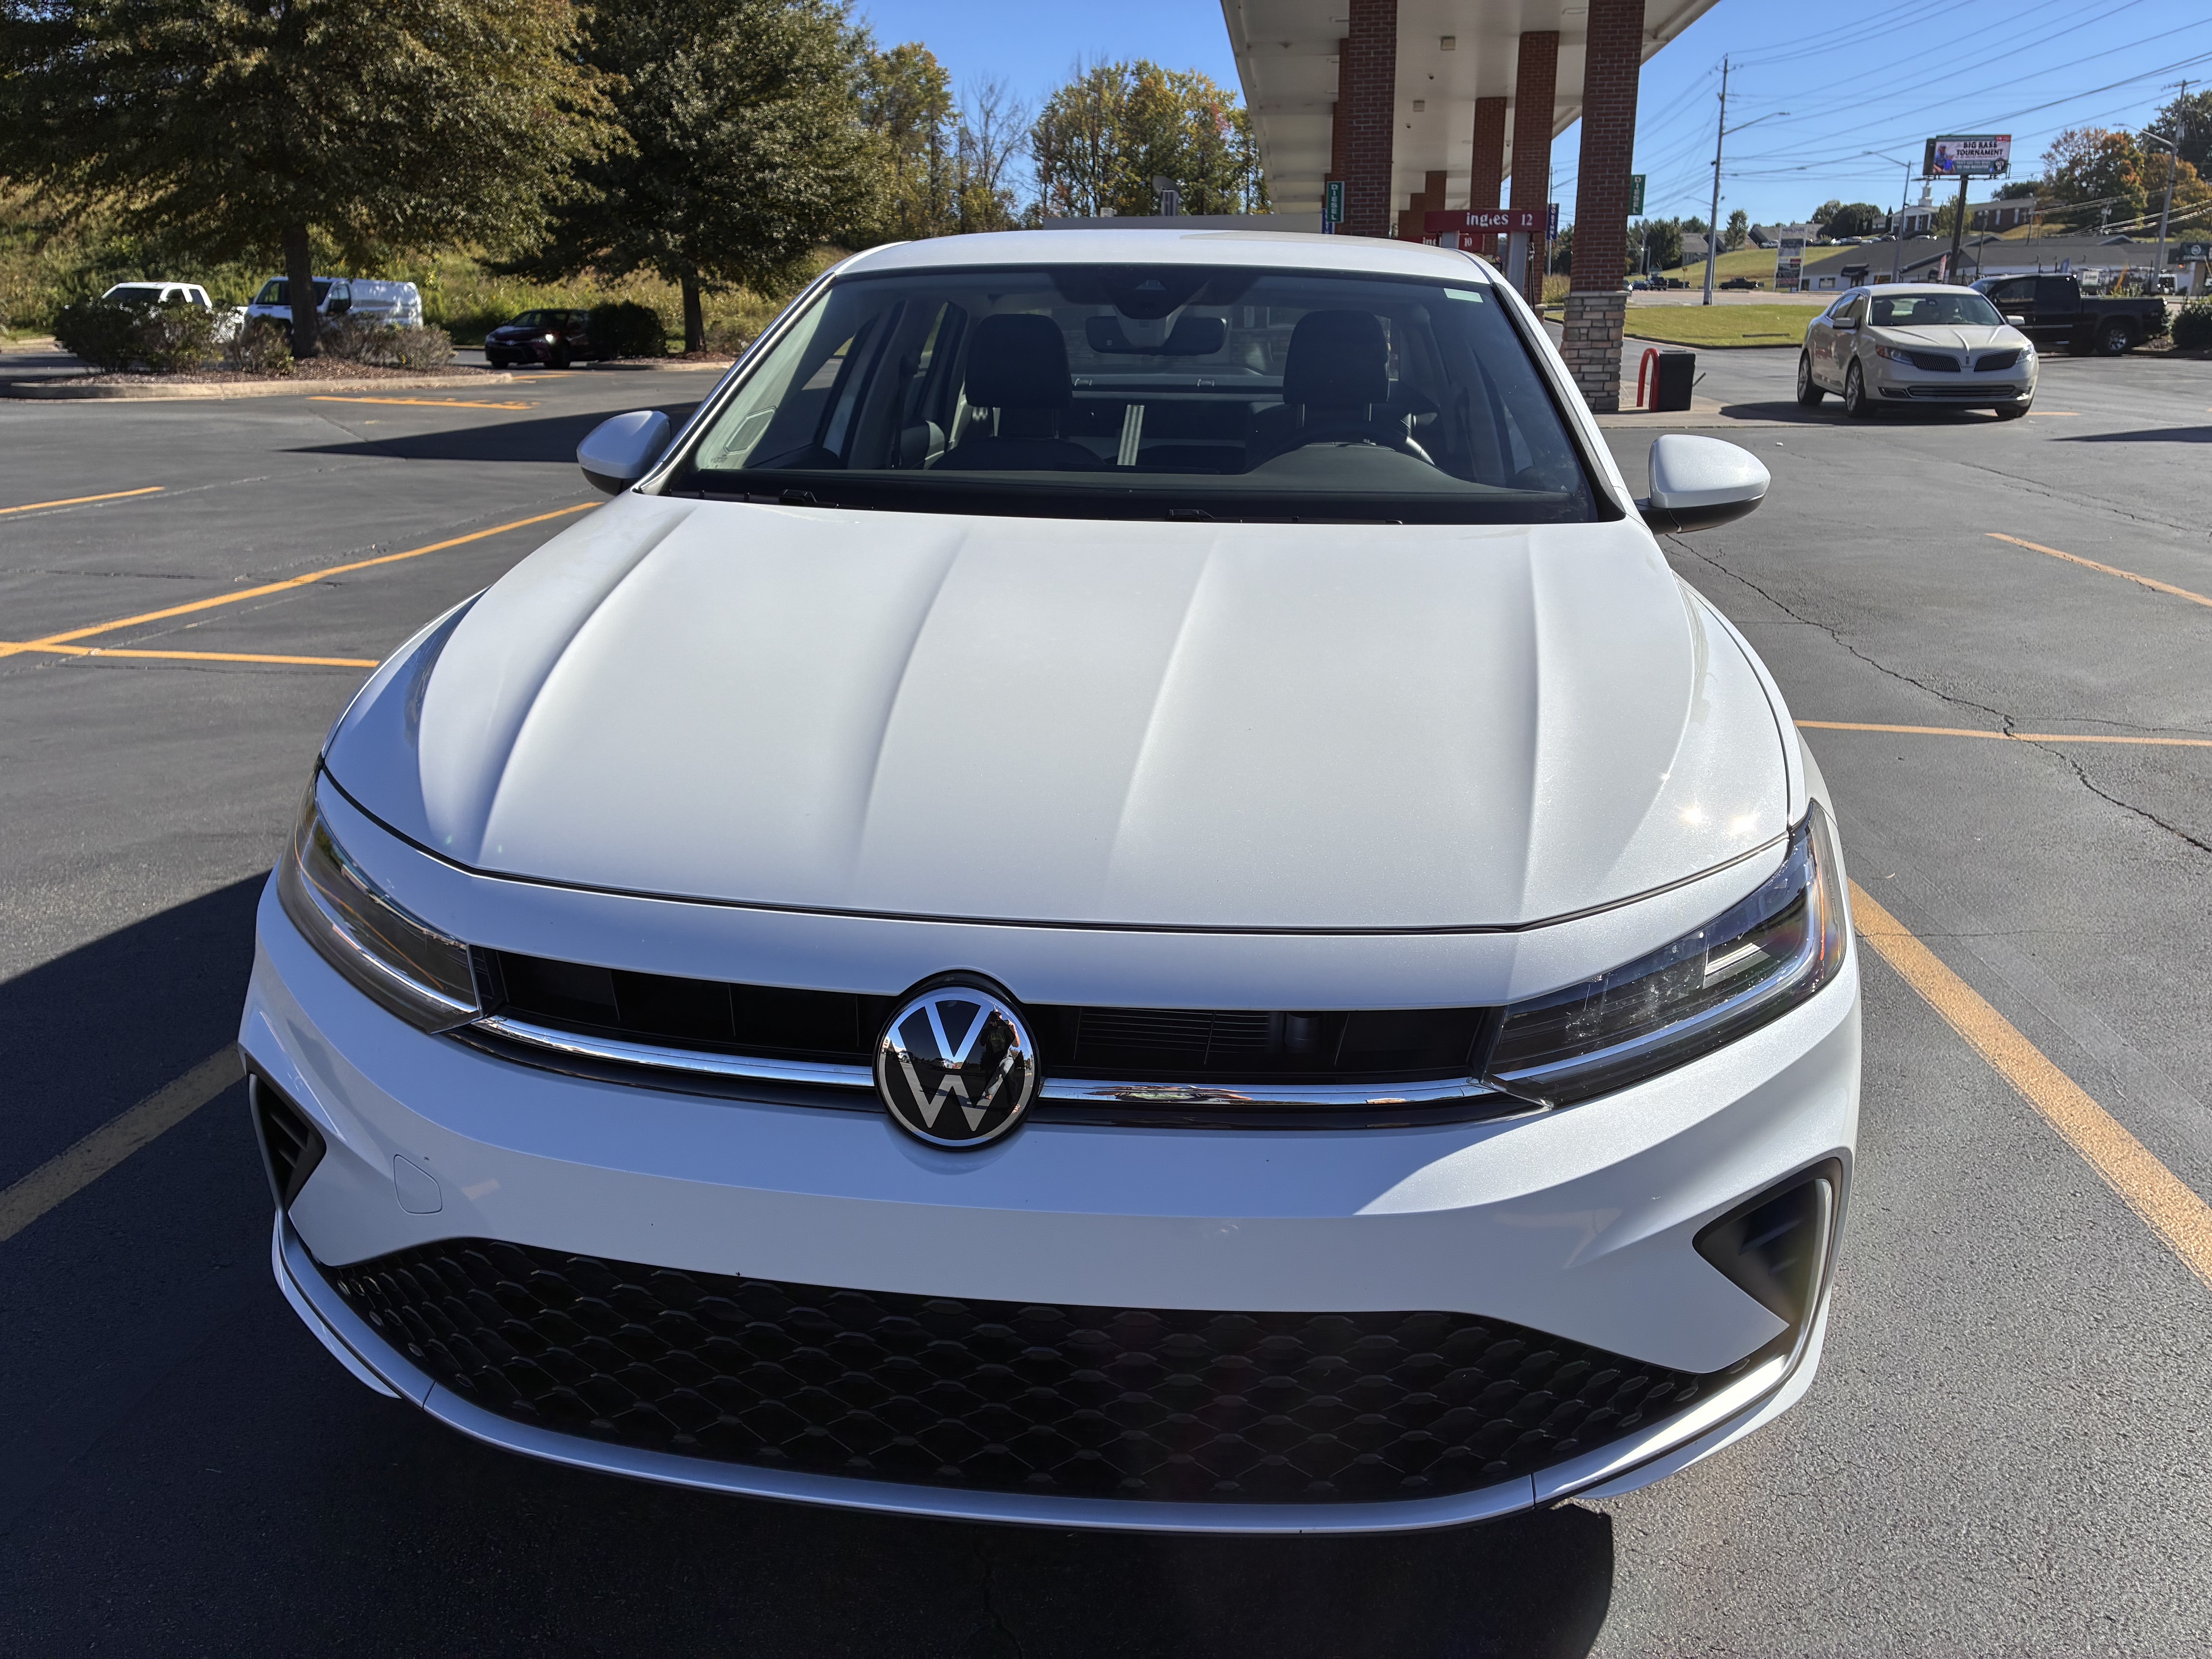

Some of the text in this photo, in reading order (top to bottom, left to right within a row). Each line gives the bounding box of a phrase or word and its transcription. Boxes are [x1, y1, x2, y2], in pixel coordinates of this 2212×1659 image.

[1633, 176, 1642, 214] DIESEL
[1521, 214, 1533, 226] 12
[1464, 237, 1473, 247] 10
